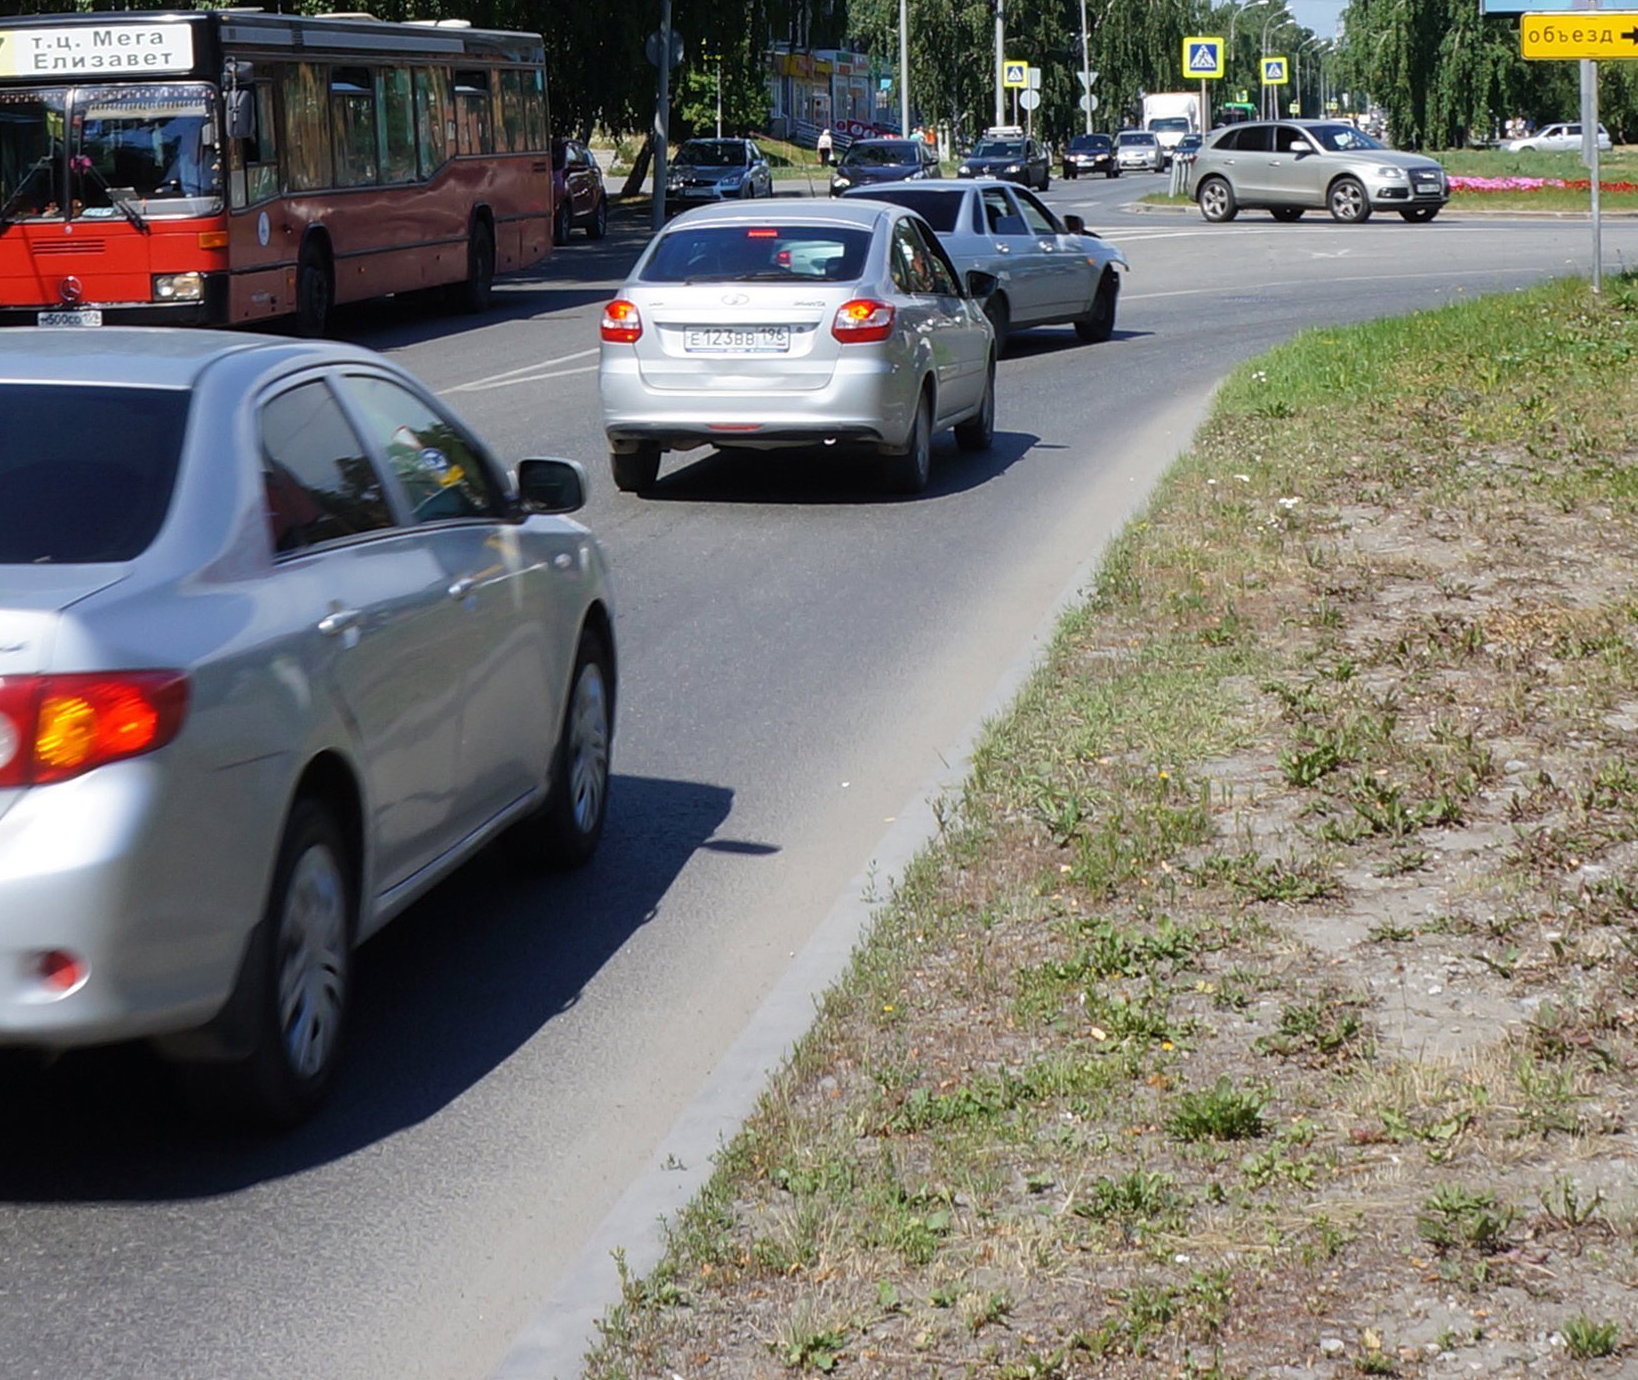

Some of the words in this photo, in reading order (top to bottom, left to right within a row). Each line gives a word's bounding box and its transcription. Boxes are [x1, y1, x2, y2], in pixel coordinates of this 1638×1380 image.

[93, 30, 165, 48] Мега
[1528, 25, 1614, 45] объезд
[33, 50, 174, 70] Елизавет
